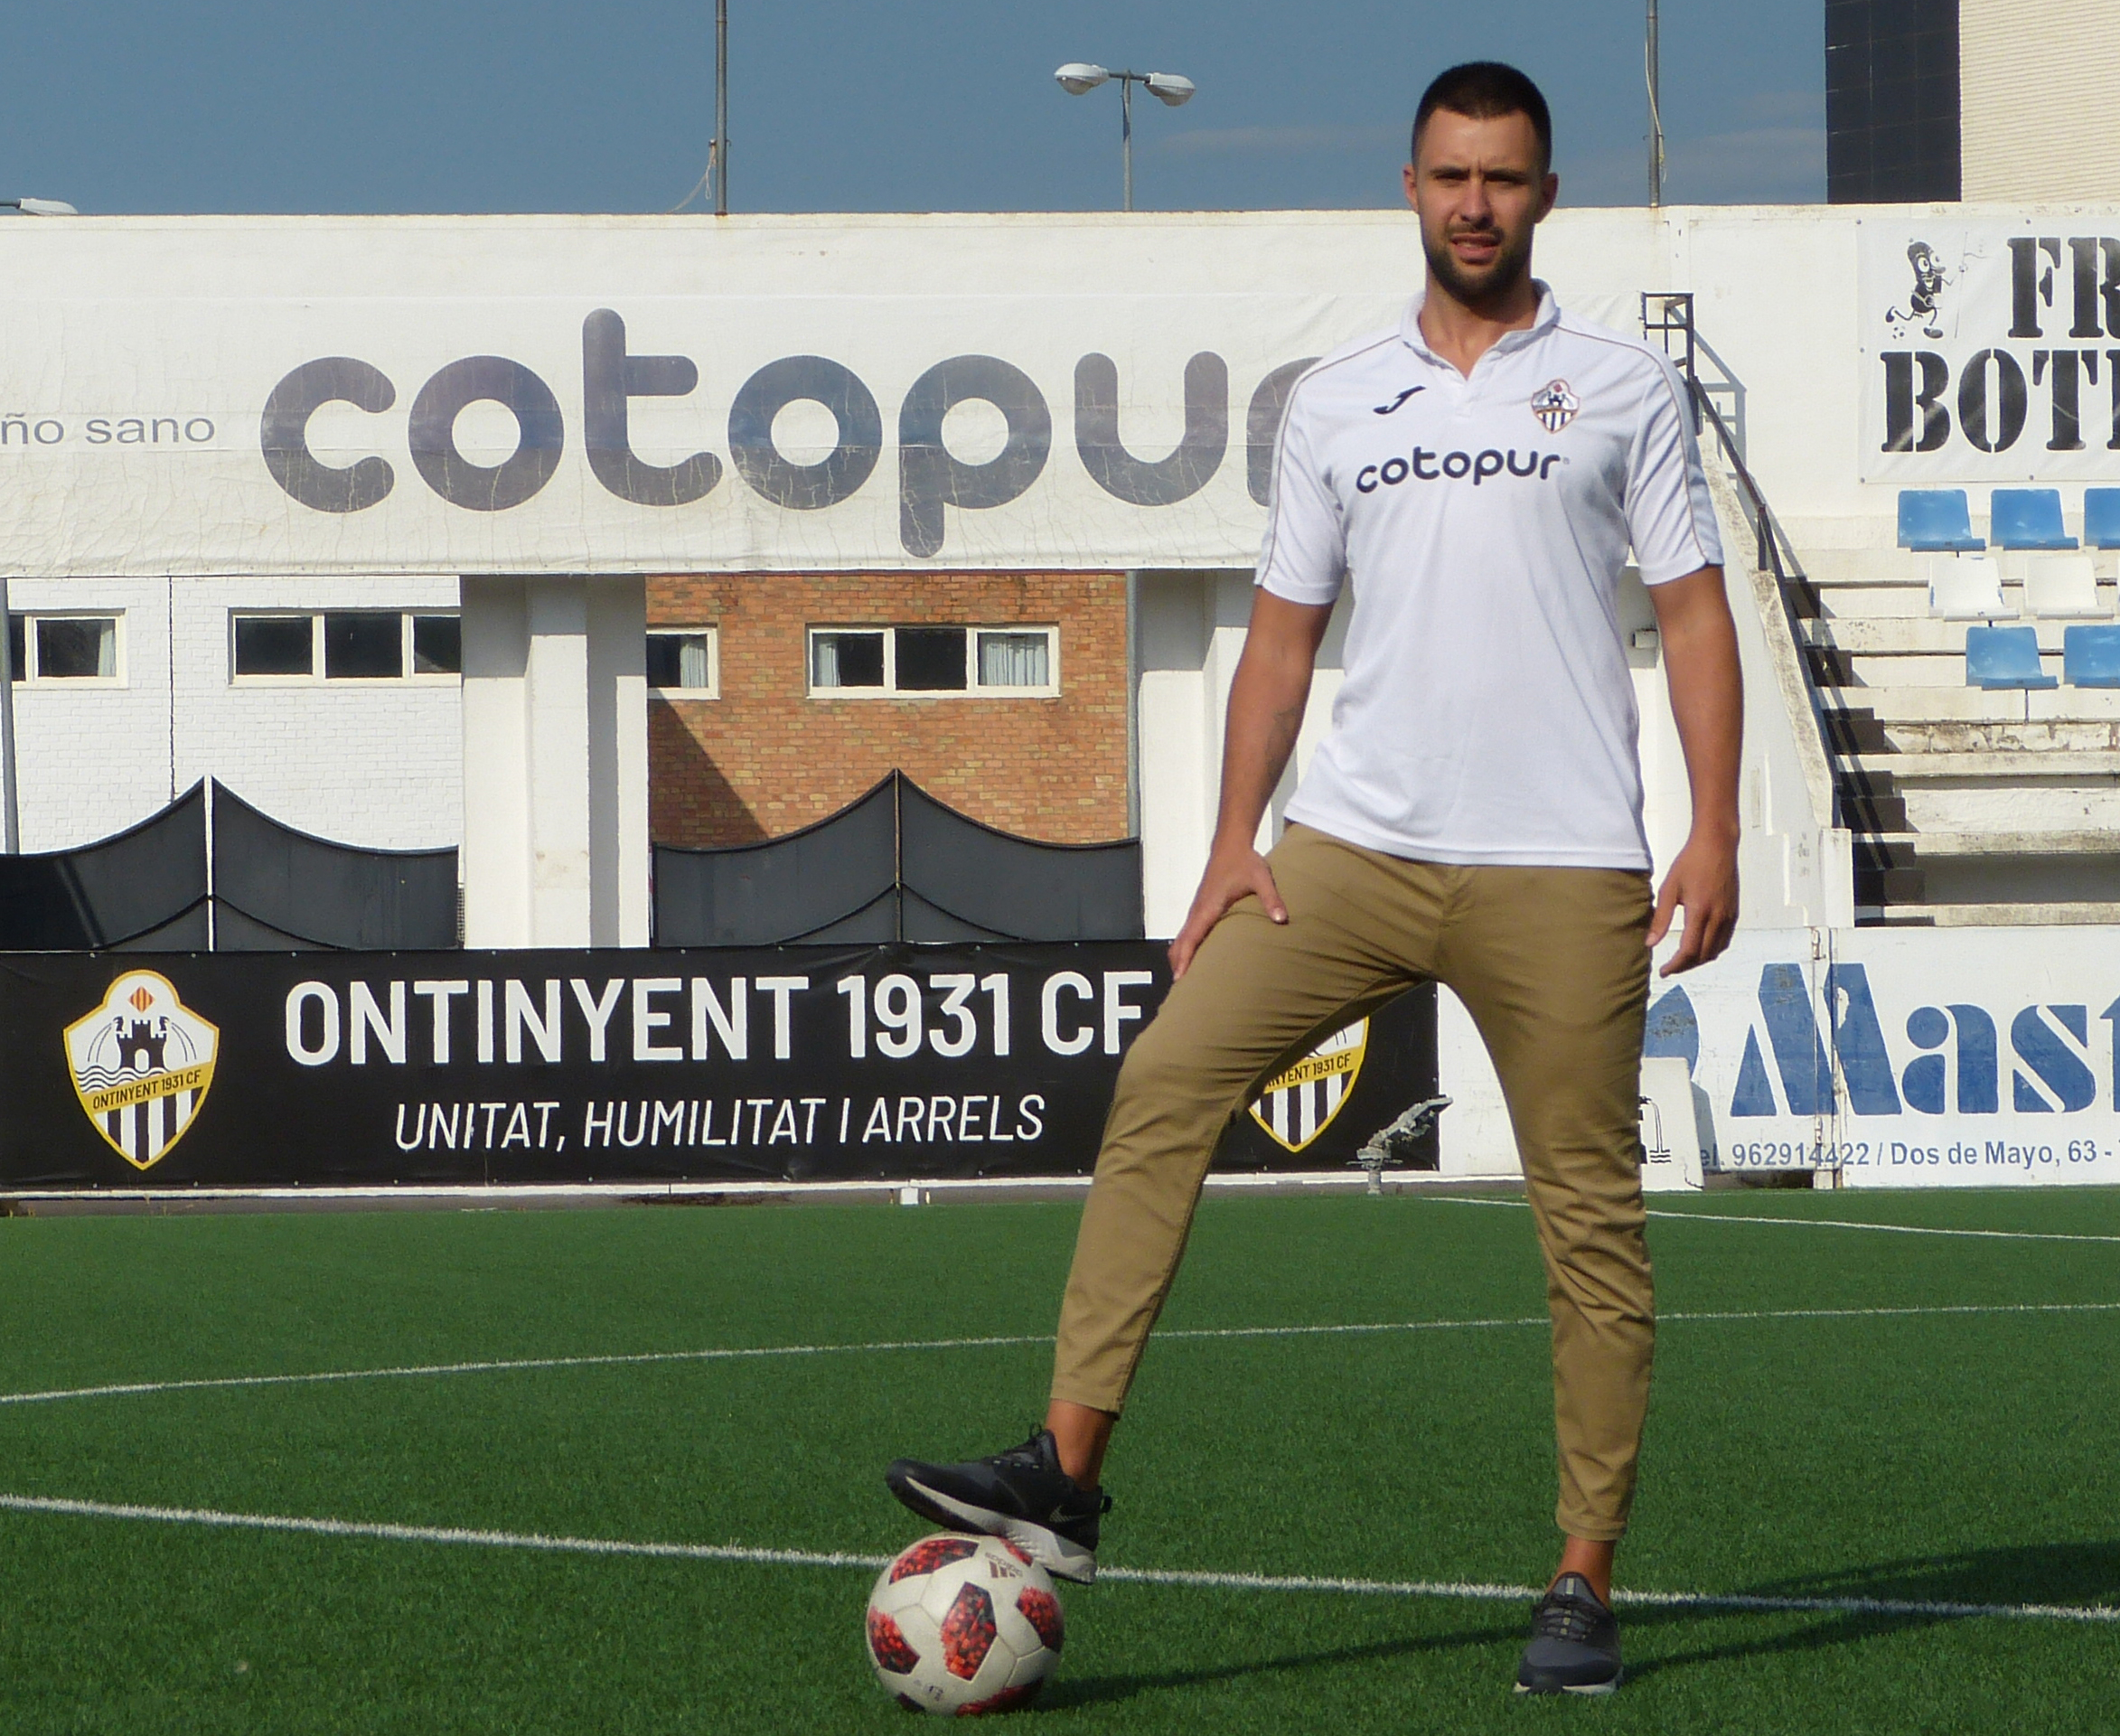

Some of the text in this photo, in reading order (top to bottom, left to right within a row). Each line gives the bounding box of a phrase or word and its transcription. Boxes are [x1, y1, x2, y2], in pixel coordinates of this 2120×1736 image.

[1880, 348, 2120, 453] BOT
[1, 412, 215, 445] ño sano
[1355, 446, 1561, 493] cotopur
[285, 971, 1153, 1066] ONTINYENT 1931 CF
[1313, 1057, 1335, 1076] 1931
[1337, 1053, 1351, 1069] CF
[93, 1069, 202, 1110] ONTINYENT 1931 CF
[396, 1093, 1046, 1152] UNITAT, HUMILITAT I ARRELS
[1700, 1143, 1724, 1167] el.
[1731, 1142, 1870, 1167] 962914422
[1890, 1142, 1940, 1165] Dos
[1947, 1141, 1977, 1164] de
[1984, 1140, 2060, 1169] Mayo,
[2068, 1140, 2097, 1163] 63
